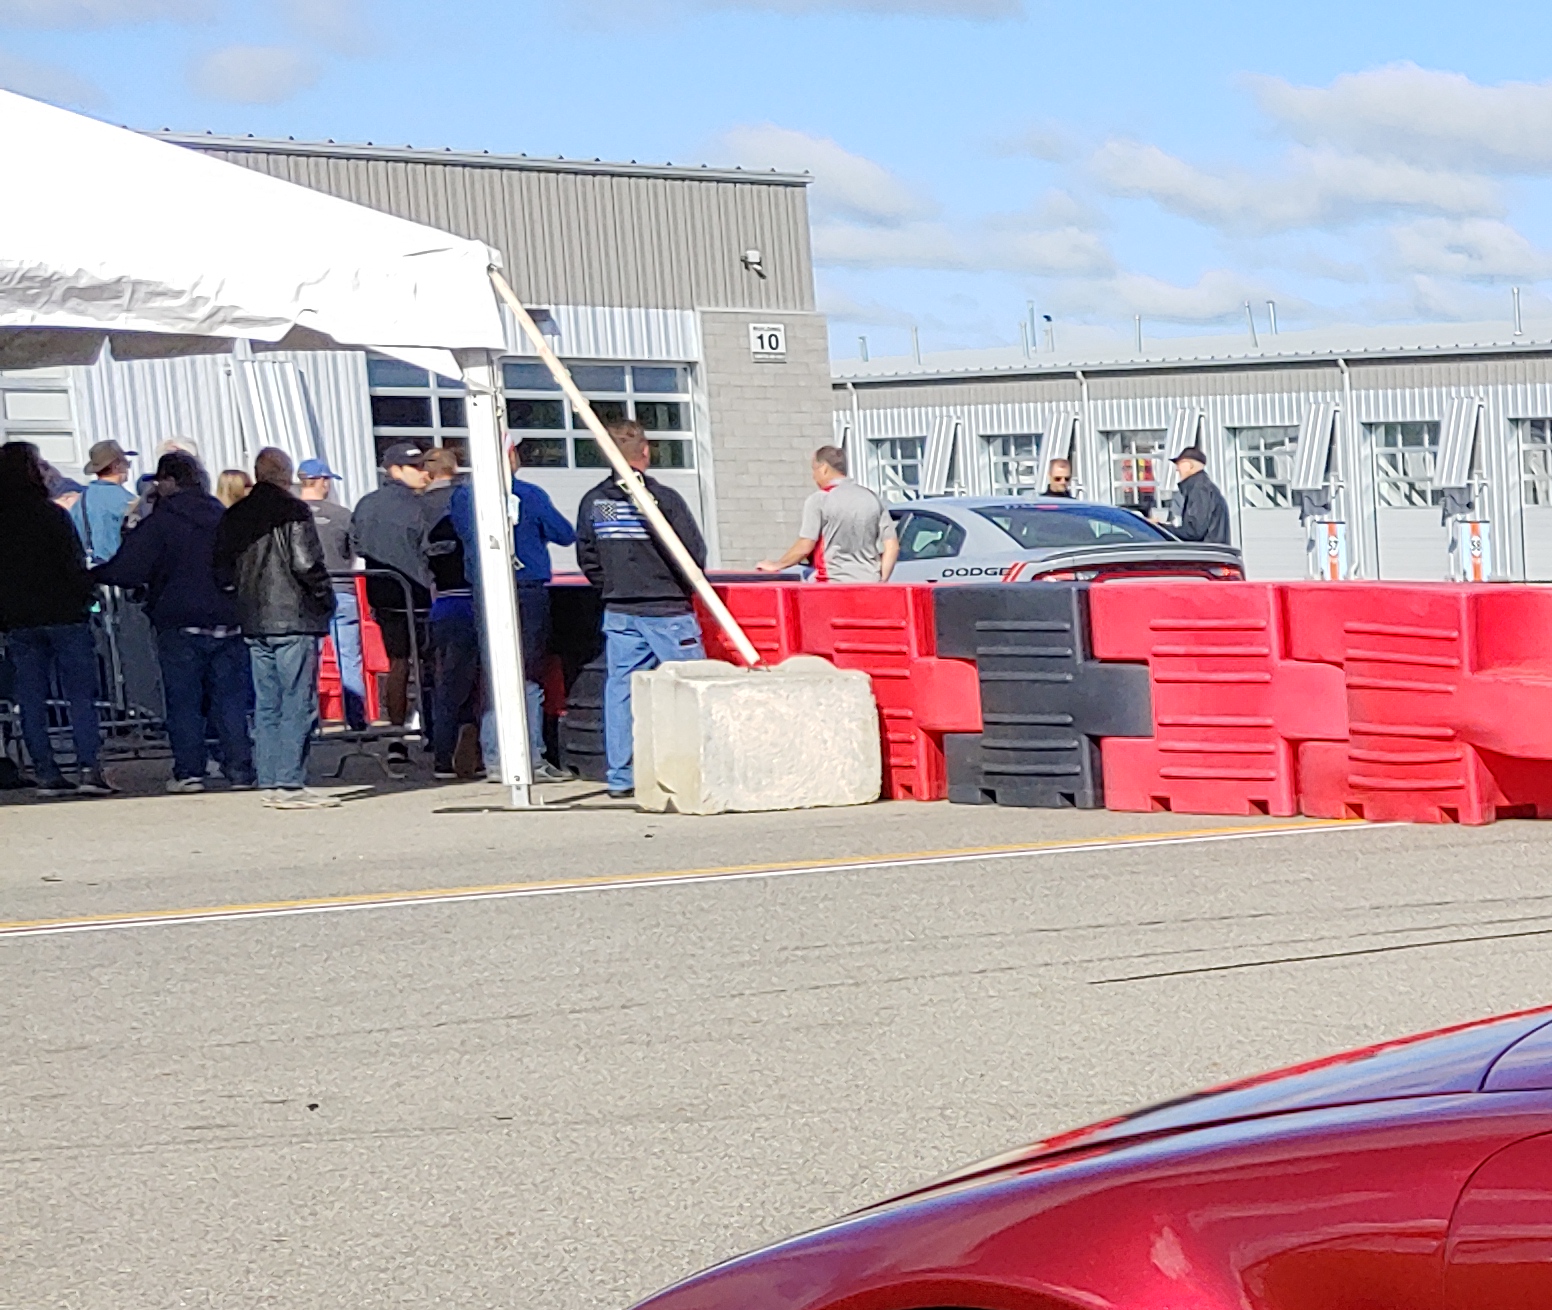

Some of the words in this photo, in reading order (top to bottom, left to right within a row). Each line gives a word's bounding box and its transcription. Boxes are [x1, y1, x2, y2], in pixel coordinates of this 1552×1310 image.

[757, 333, 779, 350] 10
[1328, 540, 1338, 551] 57
[942, 567, 1012, 578] DODGE
